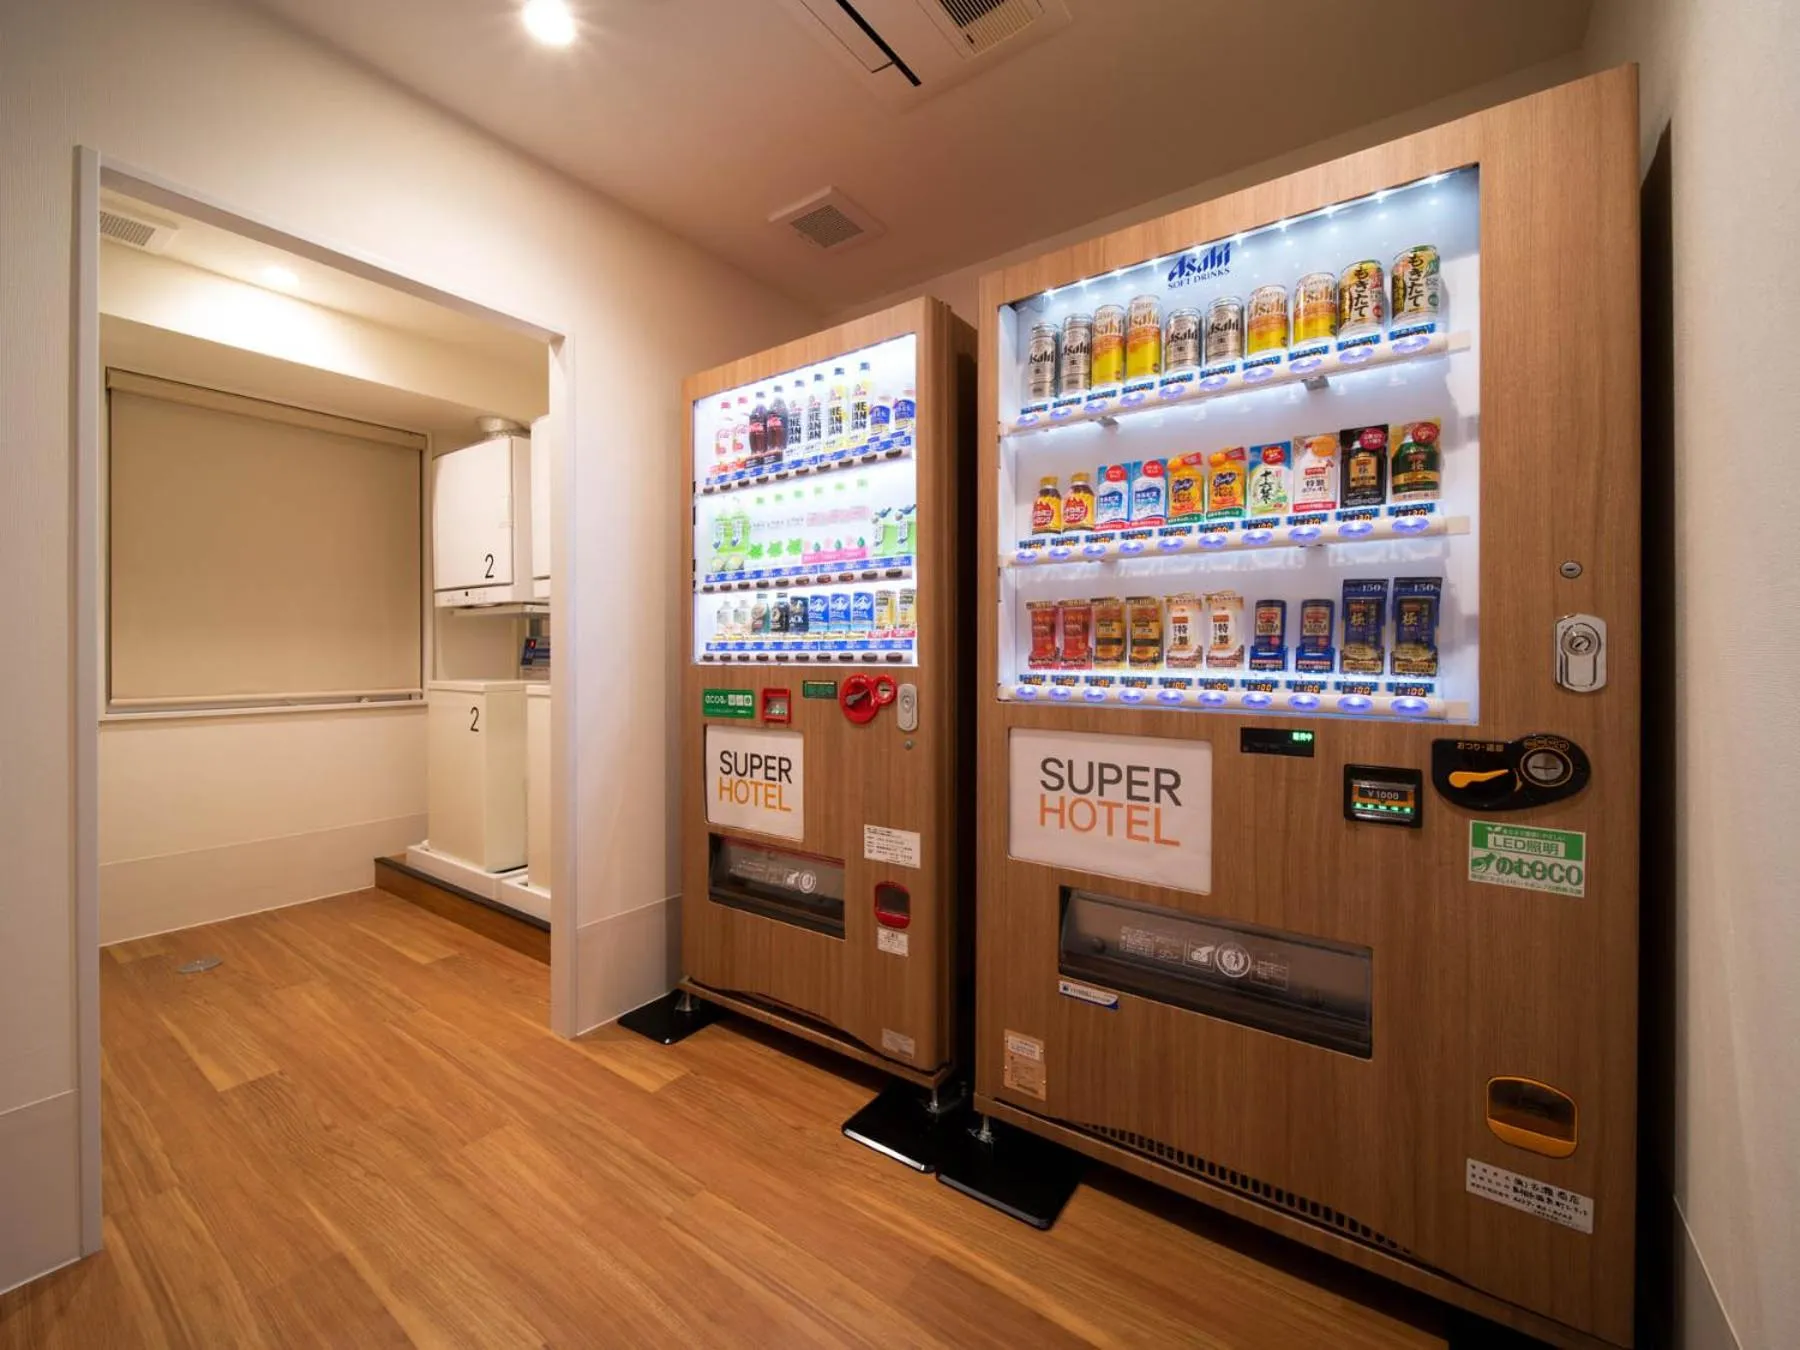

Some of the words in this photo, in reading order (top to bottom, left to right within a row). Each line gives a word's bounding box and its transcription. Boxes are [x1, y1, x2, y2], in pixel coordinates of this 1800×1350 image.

[1168, 241, 1230, 281] Asahi
[1168, 278, 1190, 289] SOFT
[1193, 268, 1230, 284] DRINKS
[1354, 264, 1369, 317] もぎたて
[1408, 253, 1424, 307] もぎたて
[485, 554, 494, 579] 2
[1362, 583, 1381, 592] 150
[1413, 583, 1434, 592] 150
[1257, 683, 1272, 691] 100
[1303, 685, 1320, 693] 100
[1353, 686, 1370, 694] 100
[1406, 687, 1424, 696] 100
[470, 707, 480, 732] 2
[719, 750, 792, 784] SUPER
[719, 777, 791, 812] HOTEL
[1040, 757, 1182, 807] SUPER
[1039, 794, 1180, 847] HOTEL
[1493, 836, 1560, 855] LED照明
